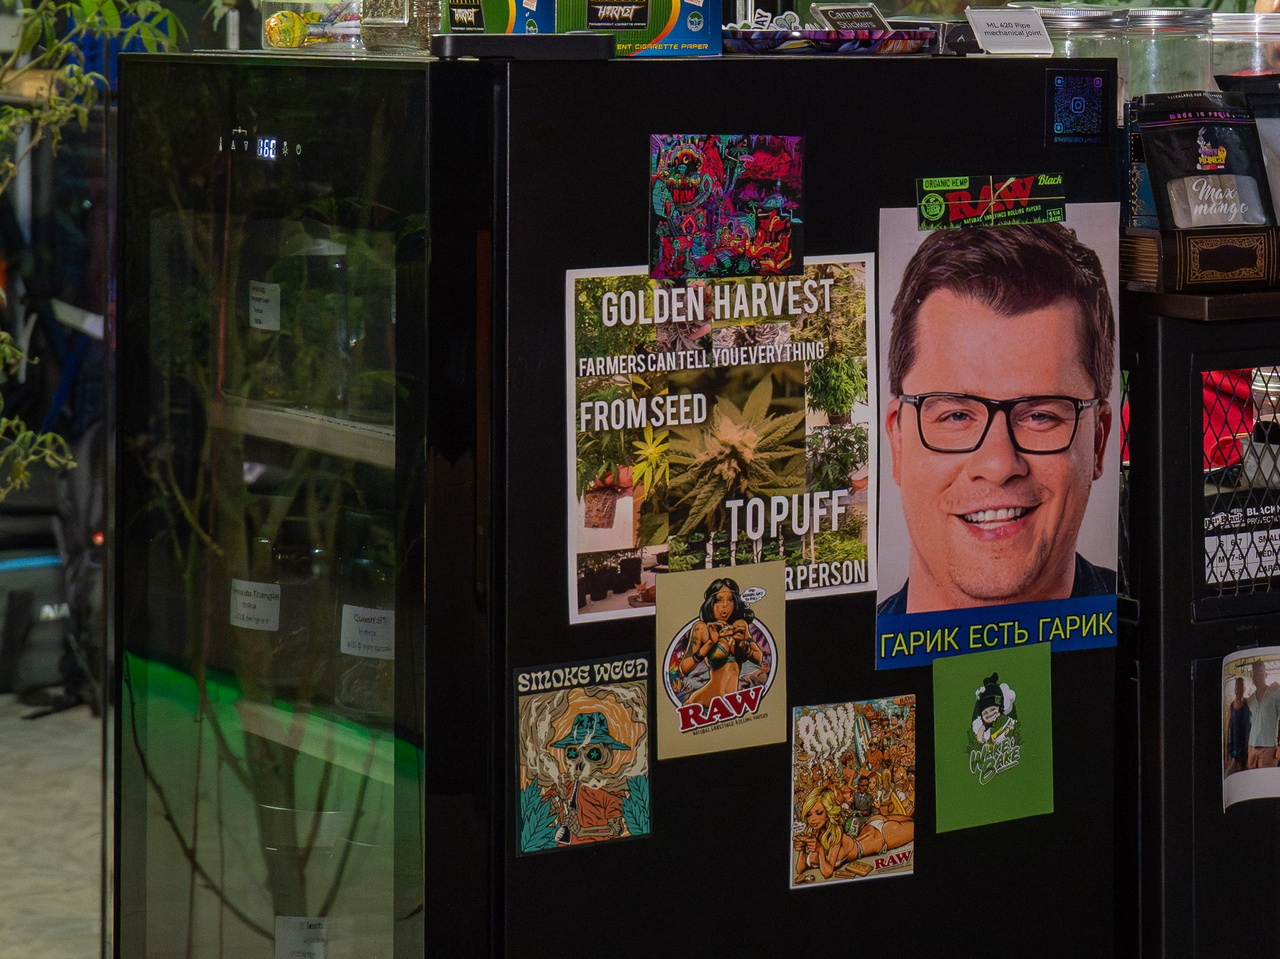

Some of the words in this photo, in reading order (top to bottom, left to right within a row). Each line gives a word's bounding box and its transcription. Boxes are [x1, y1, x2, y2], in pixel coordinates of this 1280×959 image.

[828, 10, 873, 20] Cannabis
[837, 20, 877, 29] Stickers
[1014, 22, 1031, 30] Pipe
[925, 178, 950, 188] ORGANIC
[951, 177, 968, 188] HEMP
[1037, 173, 1063, 186] Black
[1192, 178, 1237, 204] Max
[945, 176, 1035, 221] RAW
[1193, 201, 1249, 221] mango
[602, 286, 705, 327] GOLDEN
[714, 279, 834, 320] HARVEST
[579, 353, 646, 377] FARMERS
[648, 351, 676, 372] CAN
[677, 349, 710, 370] TELL
[712, 346, 740, 367] YOU
[740, 341, 825, 366] EVERYTHING
[580, 397, 648, 432] FROM
[650, 393, 707, 427] SEED
[725, 497, 765, 541] TO
[770, 489, 849, 538] PUFF
[1246, 506, 1276, 516] BLACK
[797, 559, 866, 590] PERSON
[880, 627, 960, 658] ГАРИК
[968, 621, 1029, 648] ЕСТЬ
[1038, 611, 1115, 643] ГАРИК
[518, 665, 590, 692] SMOKE
[595, 658, 648, 682] WEED
[676, 685, 764, 732] RAW
[874, 850, 912, 870] RAW
